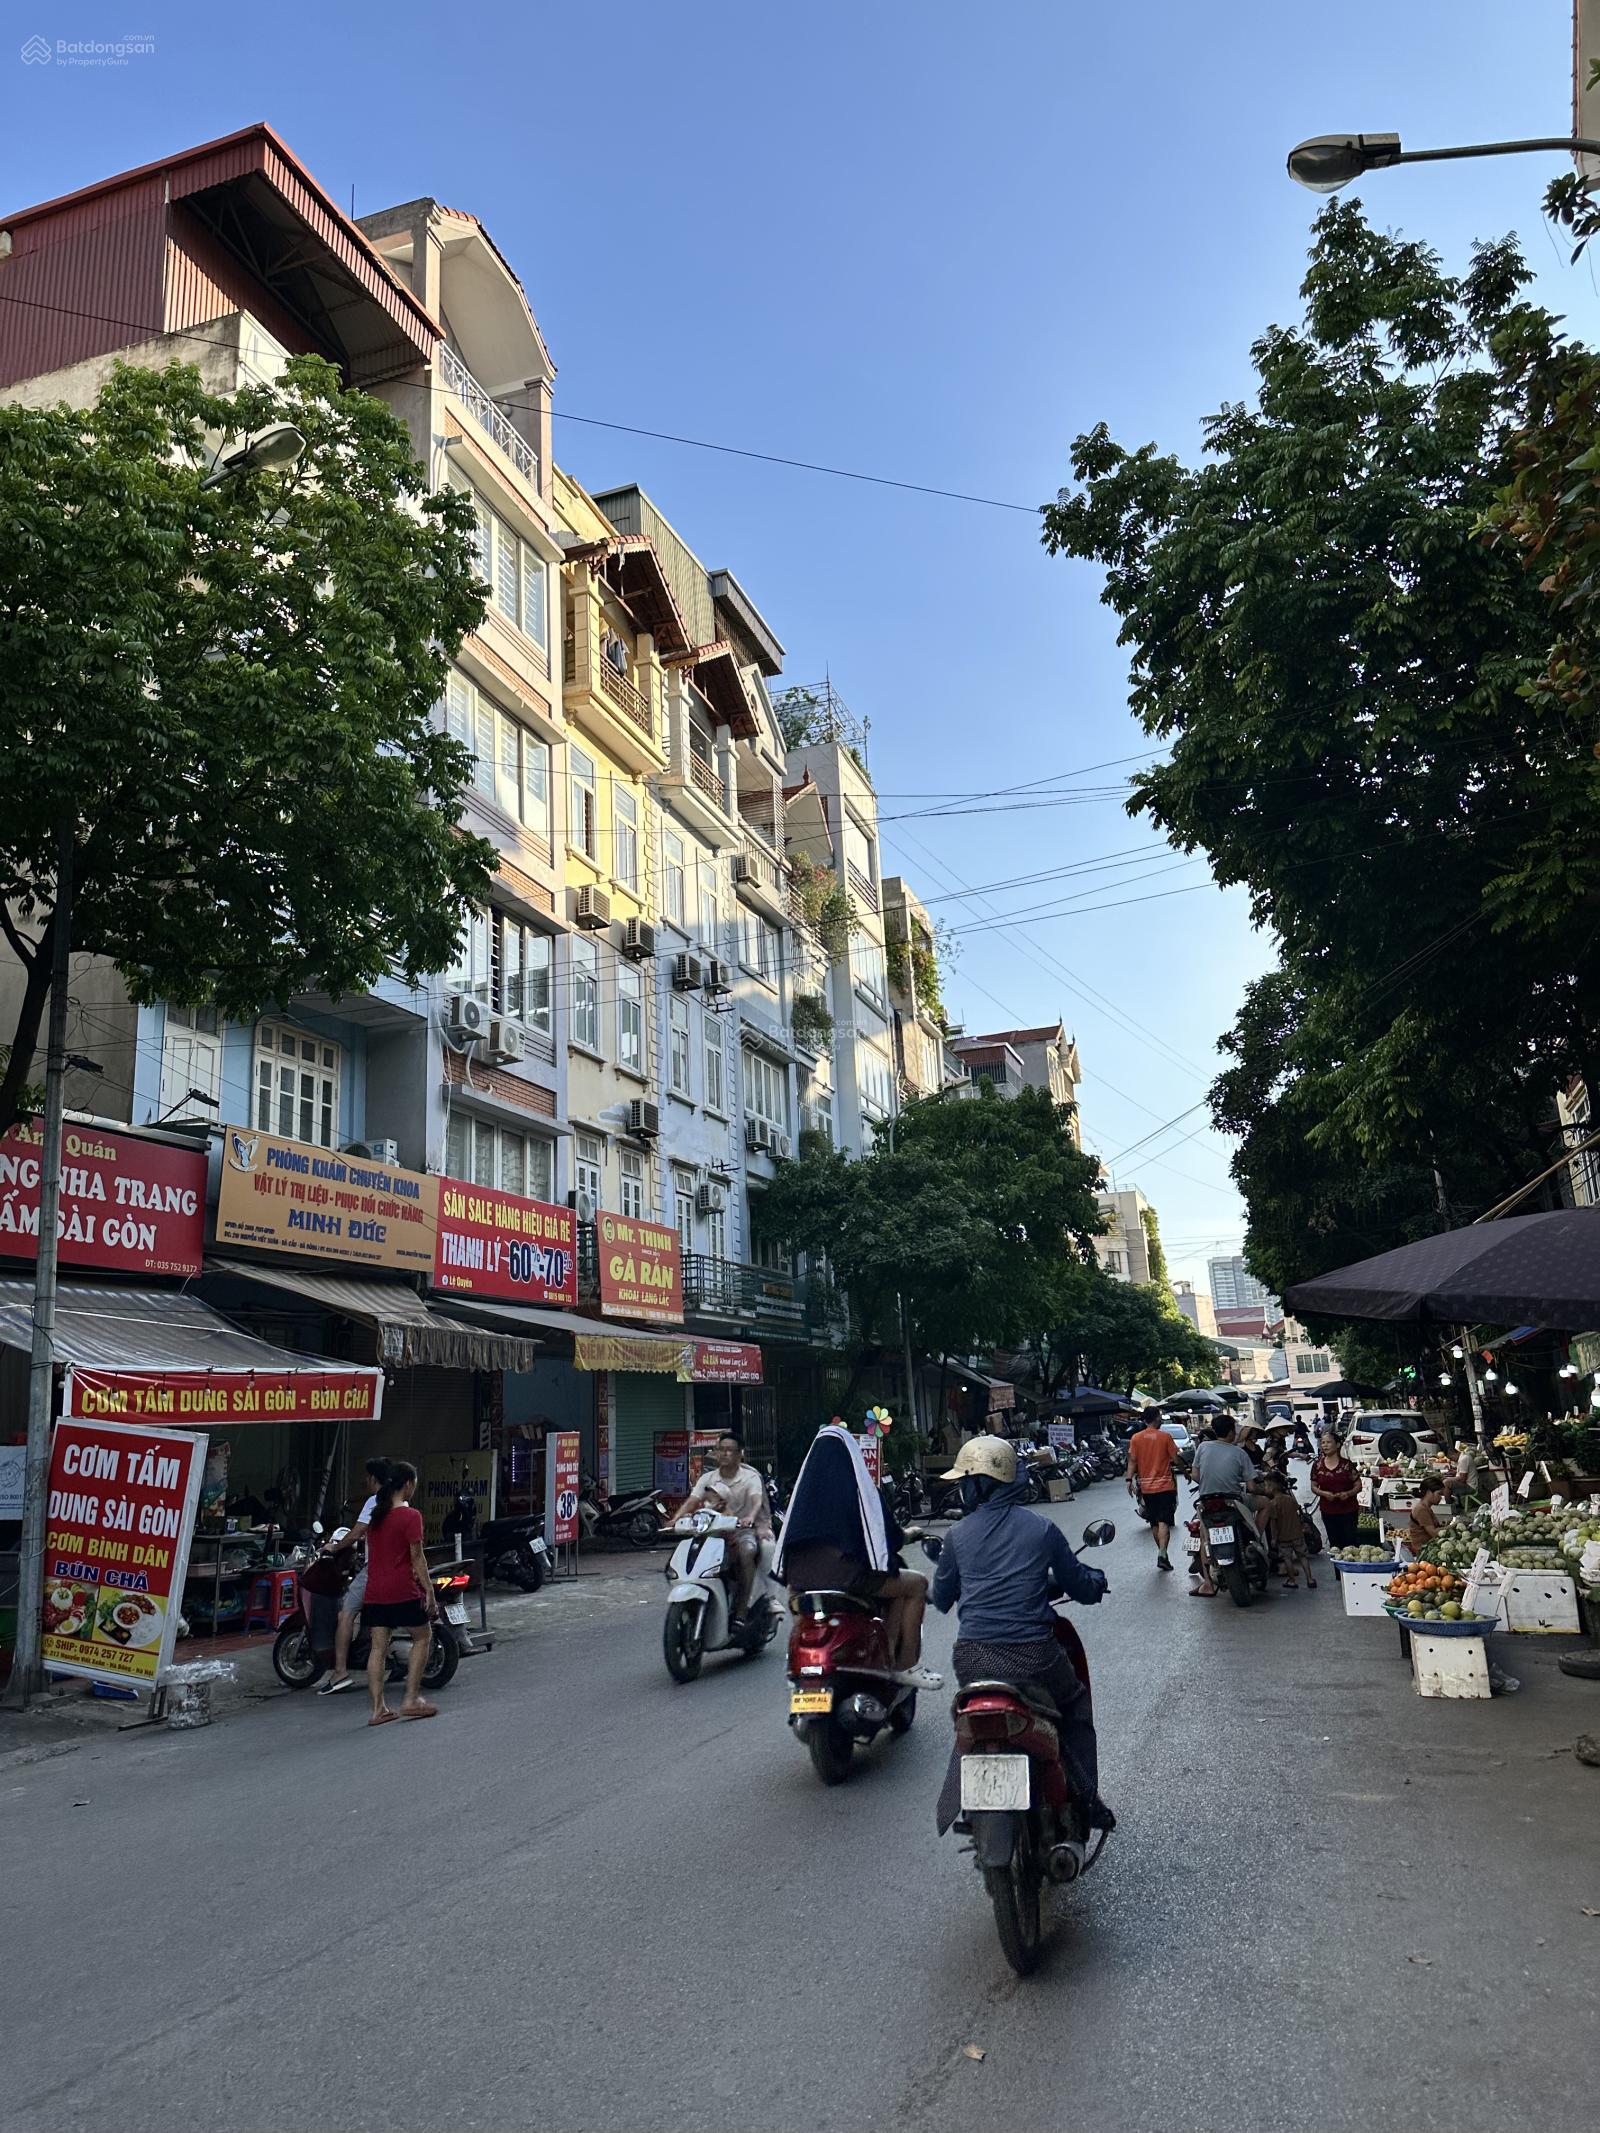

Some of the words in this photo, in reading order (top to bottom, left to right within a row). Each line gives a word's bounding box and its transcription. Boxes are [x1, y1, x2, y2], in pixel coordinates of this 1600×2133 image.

[66, 1134, 117, 1161] Quán
[59, 1166, 107, 1201] NHA
[114, 1176, 198, 1216] TRANG
[266, 1147, 310, 1174] PHÒNG
[312, 1158, 347, 1183] KHÁM
[349, 1167, 392, 1193] CHUYÊN
[393, 1178, 420, 1200] KHOA
[254, 1172, 274, 1196] VẬT
[275, 1176, 289, 1196] LÝ
[290, 1181, 306, 1204] TRỊ
[307, 1184, 329, 1207] LIỆU
[334, 1191, 360, 1213] PHỤC
[377, 1199, 400, 1219] CHỨC
[102, 1213, 157, 1252] GÒN
[288, 1208, 342, 1236] MINH
[349, 1218, 387, 1244] ĐỨC
[443, 1187, 466, 1220] SĂN
[468, 1197, 493, 1226] SALE
[495, 1200, 521, 1232] HÀNG
[522, 1208, 543, 1240] HIỆU
[544, 1213, 559, 1240] GIÁ
[560, 1211, 571, 1243] RẺ
[616, 1223, 636, 1244] Mr.
[442, 1231, 484, 1270] THANH
[486, 1235, 502, 1273] LÝ
[609, 1252, 637, 1283] GÀ
[640, 1257, 674, 1290] RÁN
[618, 1288, 640, 1302] KHOAI
[641, 1291, 658, 1305] LANG
[133, 1381, 175, 1413] TẤM
[180, 1389, 228, 1413] DUNG
[232, 1384, 260, 1412] SÀI
[264, 1384, 297, 1411] GÒN
[343, 1383, 369, 1409] CHẢ
[63, 1444, 120, 1481] CƠM
[126, 1444, 181, 1490] TẤM
[47, 1490, 99, 1526] DUNG
[101, 1494, 136, 1532] SÀI
[138, 1499, 181, 1539] GÒN
[46, 1531, 85, 1554] CƠM
[87, 1535, 129, 1562] BÌNH
[132, 1543, 170, 1569] DÂN
[54, 1559, 100, 1582] BÚN
[104, 1568, 149, 1592] CHẢ
[55, 1639, 78, 1653] SHIP:
[101, 1648, 117, 1661] 257
[119, 1651, 135, 1664] 727
